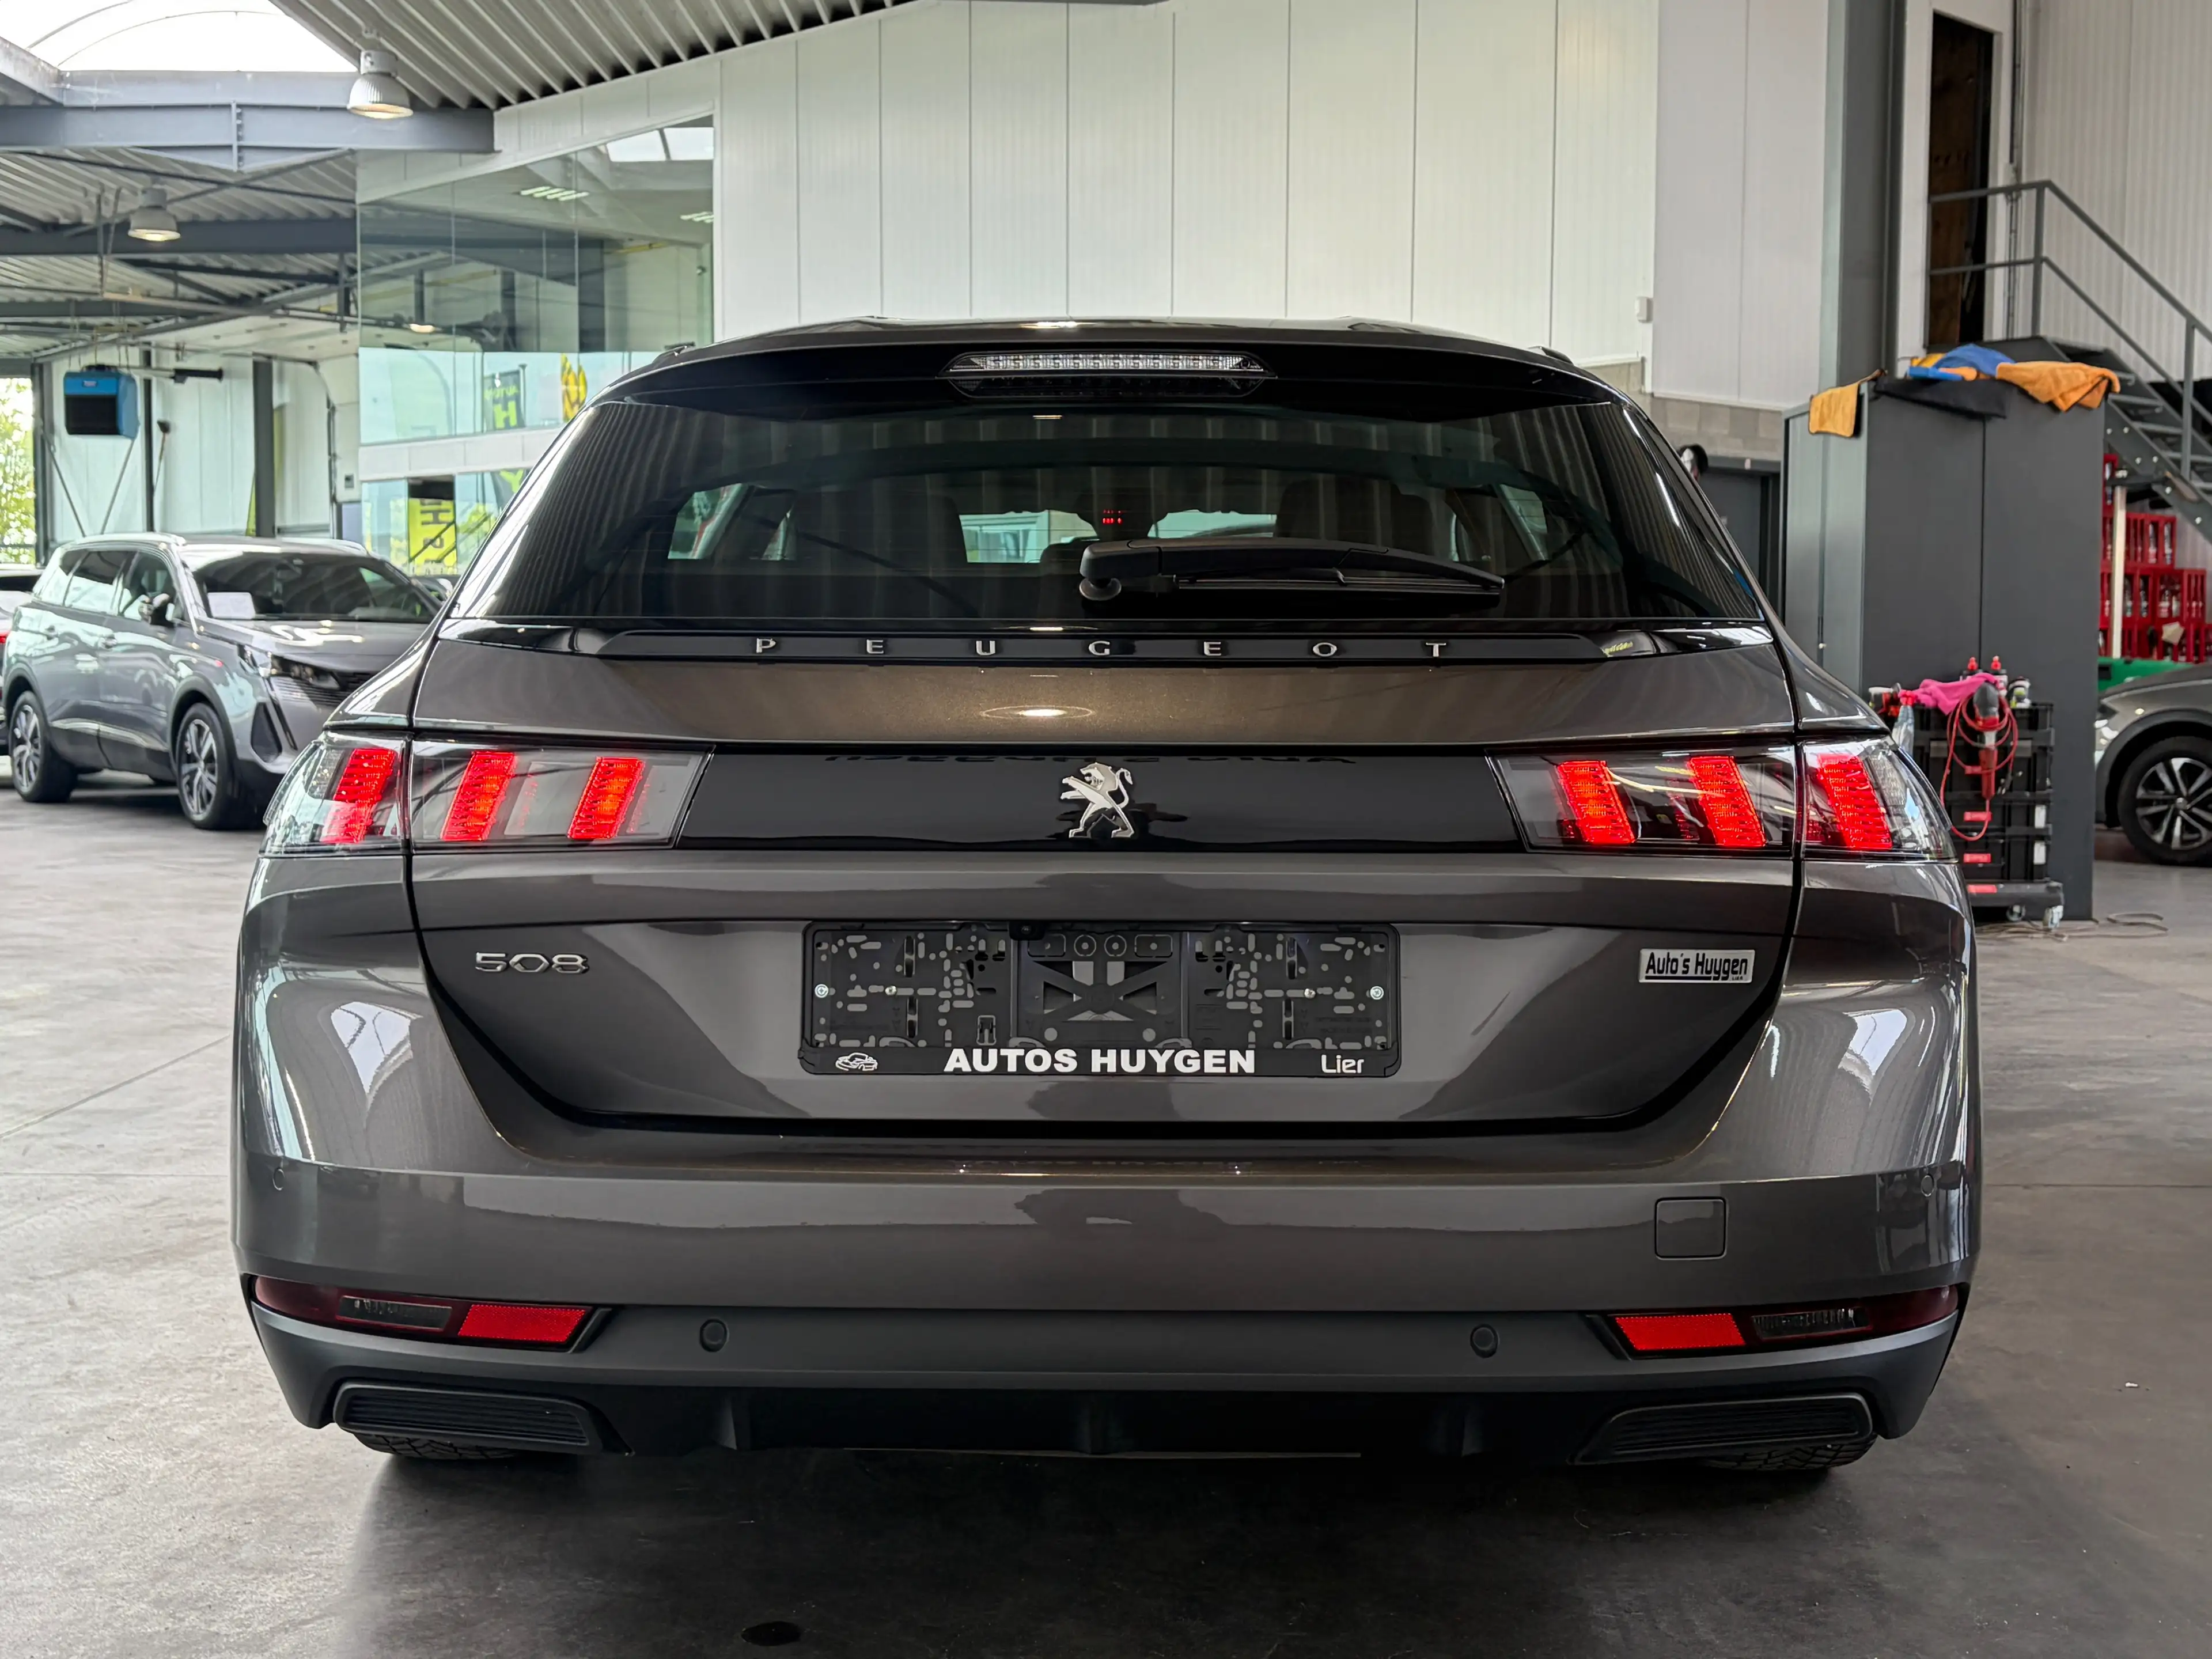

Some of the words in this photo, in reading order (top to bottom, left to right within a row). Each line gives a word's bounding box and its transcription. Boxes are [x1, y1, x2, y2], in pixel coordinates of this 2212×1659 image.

[756, 638, 1447, 657] PEUGEOT
[475, 952, 587, 974] 508
[1694, 953, 1748, 981] Huygen
[944, 1048, 1078, 1073] AUTOS
[1091, 1049, 1255, 1073] HUYGEN
[1321, 1054, 1365, 1074] Lier
